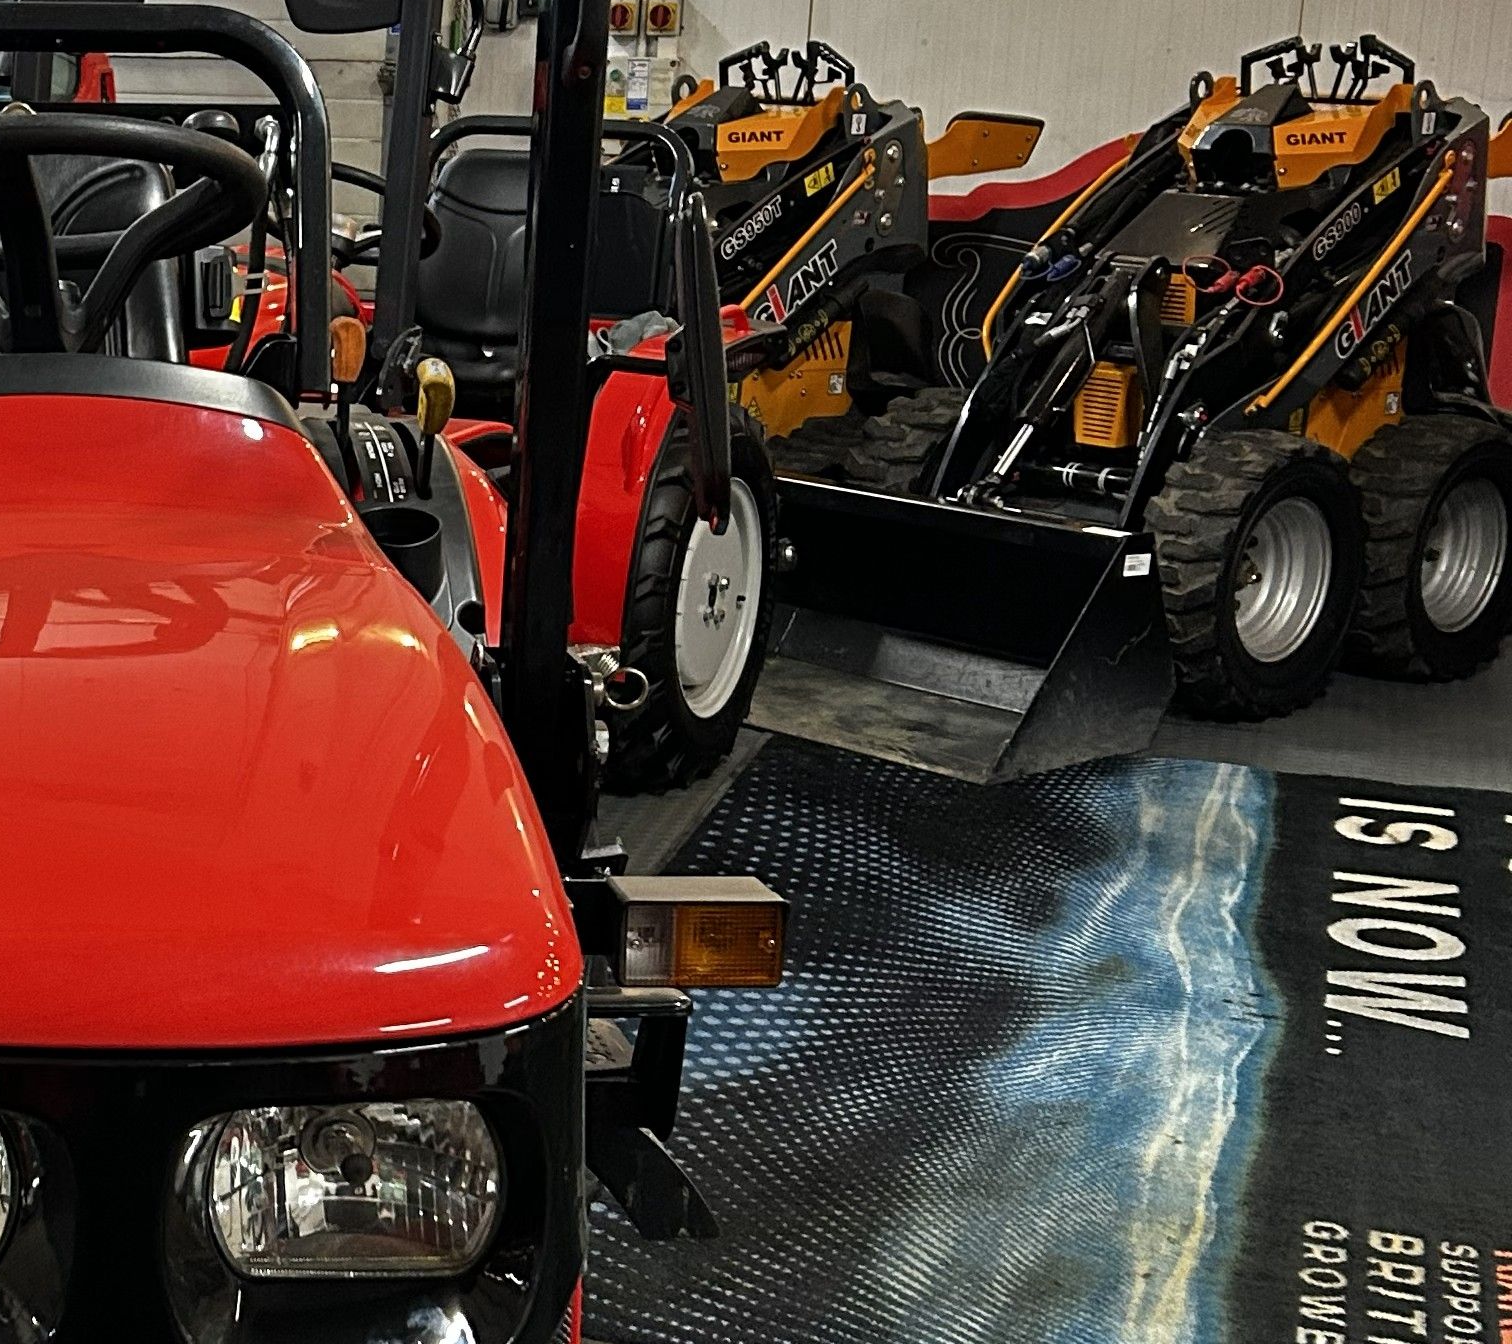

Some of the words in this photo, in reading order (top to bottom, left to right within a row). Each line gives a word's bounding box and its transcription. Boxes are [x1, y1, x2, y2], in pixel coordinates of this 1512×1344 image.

[727, 130, 785, 144] GIANT
[1286, 131, 1348, 146] GIANT
[720, 194, 782, 261] GS950T
[1312, 202, 1361, 261] GS900
[753, 238, 838, 324] GIANT
[1335, 249, 1412, 360] GIANT
[1334, 796, 1459, 851] IS
